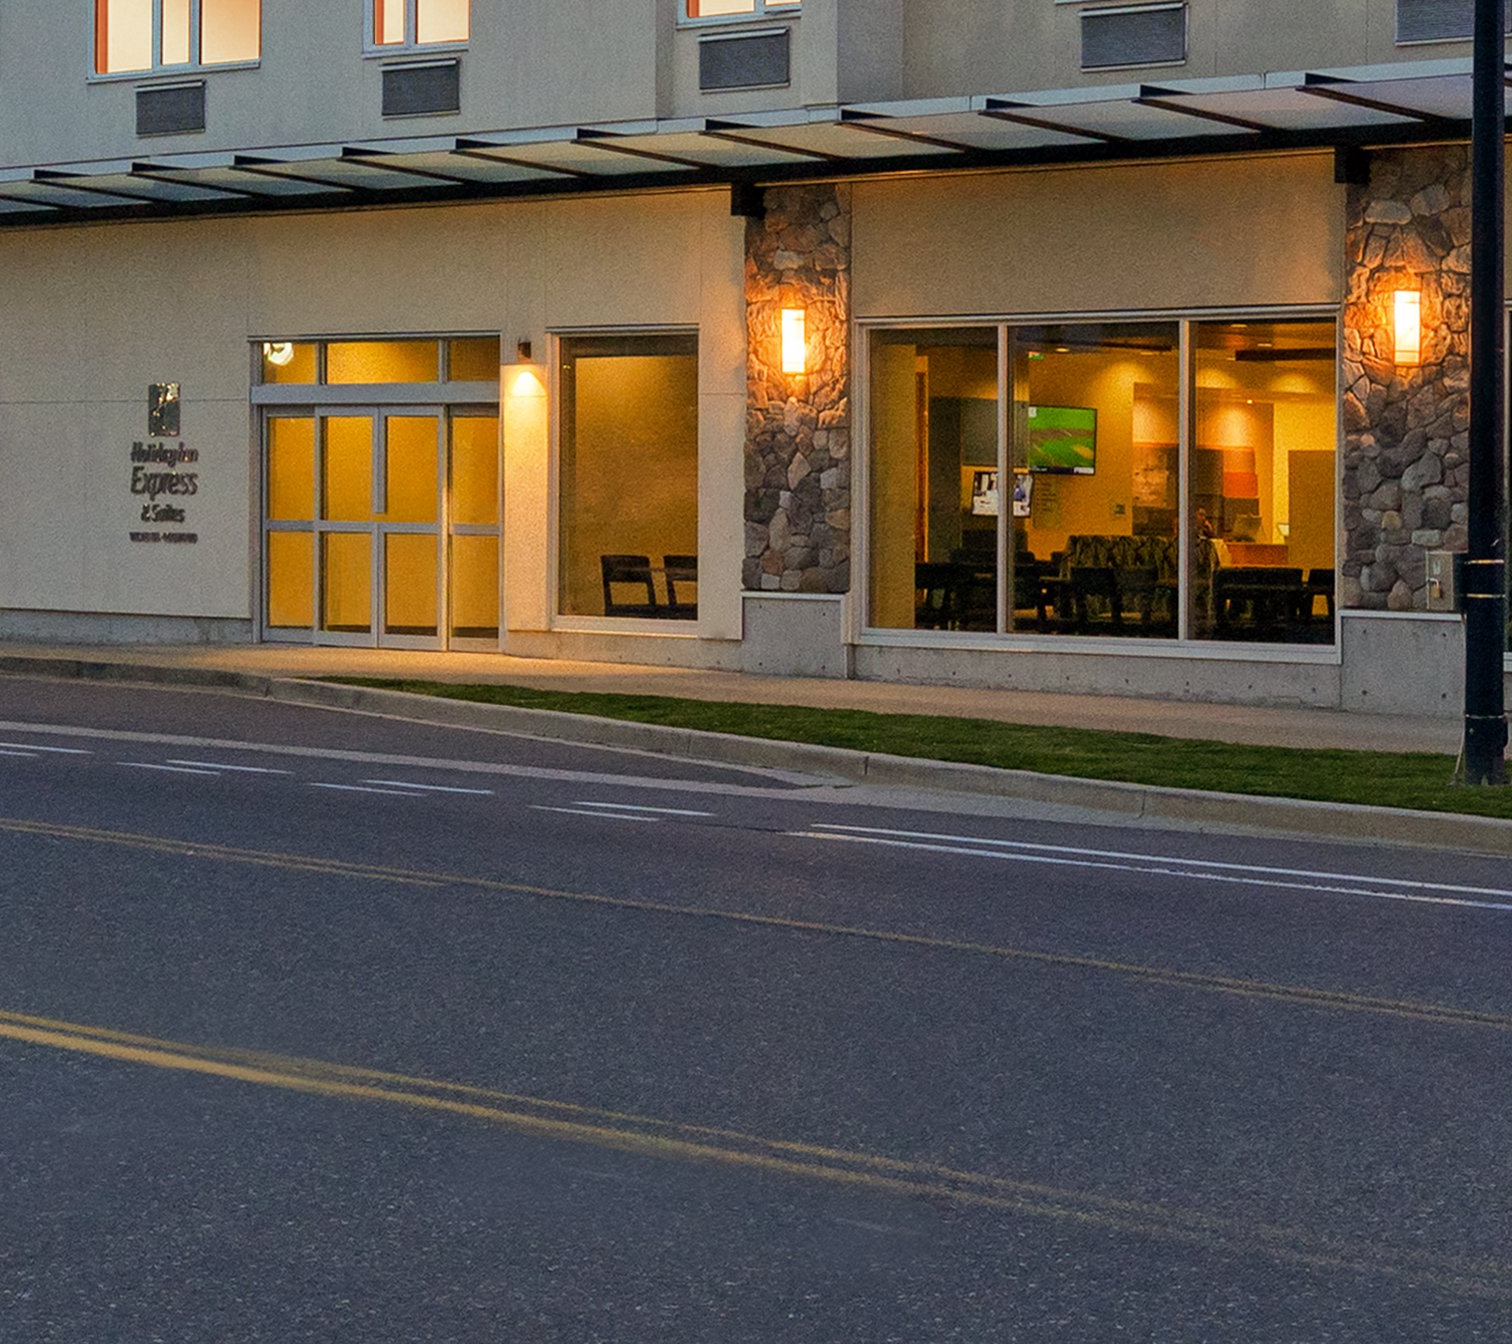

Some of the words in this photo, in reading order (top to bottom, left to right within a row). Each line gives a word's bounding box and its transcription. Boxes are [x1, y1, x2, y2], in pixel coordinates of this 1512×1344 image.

[131, 442, 178, 467] Holiday
[178, 442, 199, 462] Inn
[131, 466, 199, 501] Express
[151, 504, 186, 522] Suites
